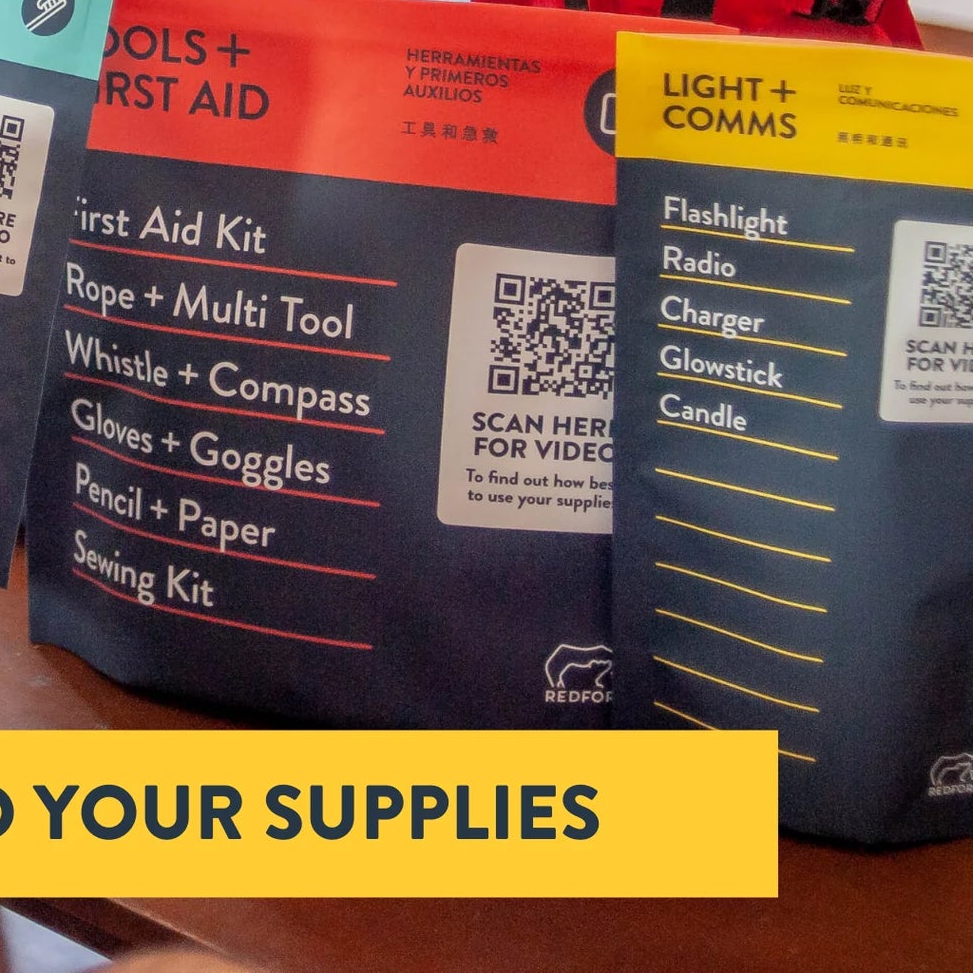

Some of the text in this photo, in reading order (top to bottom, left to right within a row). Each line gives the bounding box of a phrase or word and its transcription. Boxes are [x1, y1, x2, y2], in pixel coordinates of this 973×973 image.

[102, 25, 251, 68] OOLS +
[406, 47, 542, 74] HERRAMIENTAS
[405, 66, 509, 88] Y PRIMEROS
[663, 72, 797, 103] LIGHT +
[94, 70, 270, 120] RST AID
[403, 84, 483, 104] AUXILIOS
[838, 95, 959, 118] COMUNICACIONES
[662, 105, 798, 139] COMMS
[74, 195, 267, 254] irst Aid Kit
[663, 195, 789, 241] Flashlight
[5, 256, 16, 265] to
[663, 245, 737, 277] Radio
[66, 262, 353, 339] Rope + Multi Tool
[660, 295, 765, 339] Charger
[905, 339, 957, 355] SCAN
[65, 329, 371, 420] Whistle + Compass
[660, 345, 783, 388] Glowstick
[907, 357, 944, 372] FOR
[893, 379, 907, 390] To
[472, 411, 613, 438] SCAN HER
[659, 394, 747, 432] Candle
[71, 398, 330, 491] Gloves + Goggles
[474, 437, 527, 459] FOR
[466, 468, 614, 491] To find out how bes
[76, 462, 276, 553] Pencil + Paper
[467, 489, 613, 513] to use your supplie
[73, 530, 214, 607] Sewing Kit
[545, 690, 613, 703] REDFOR
